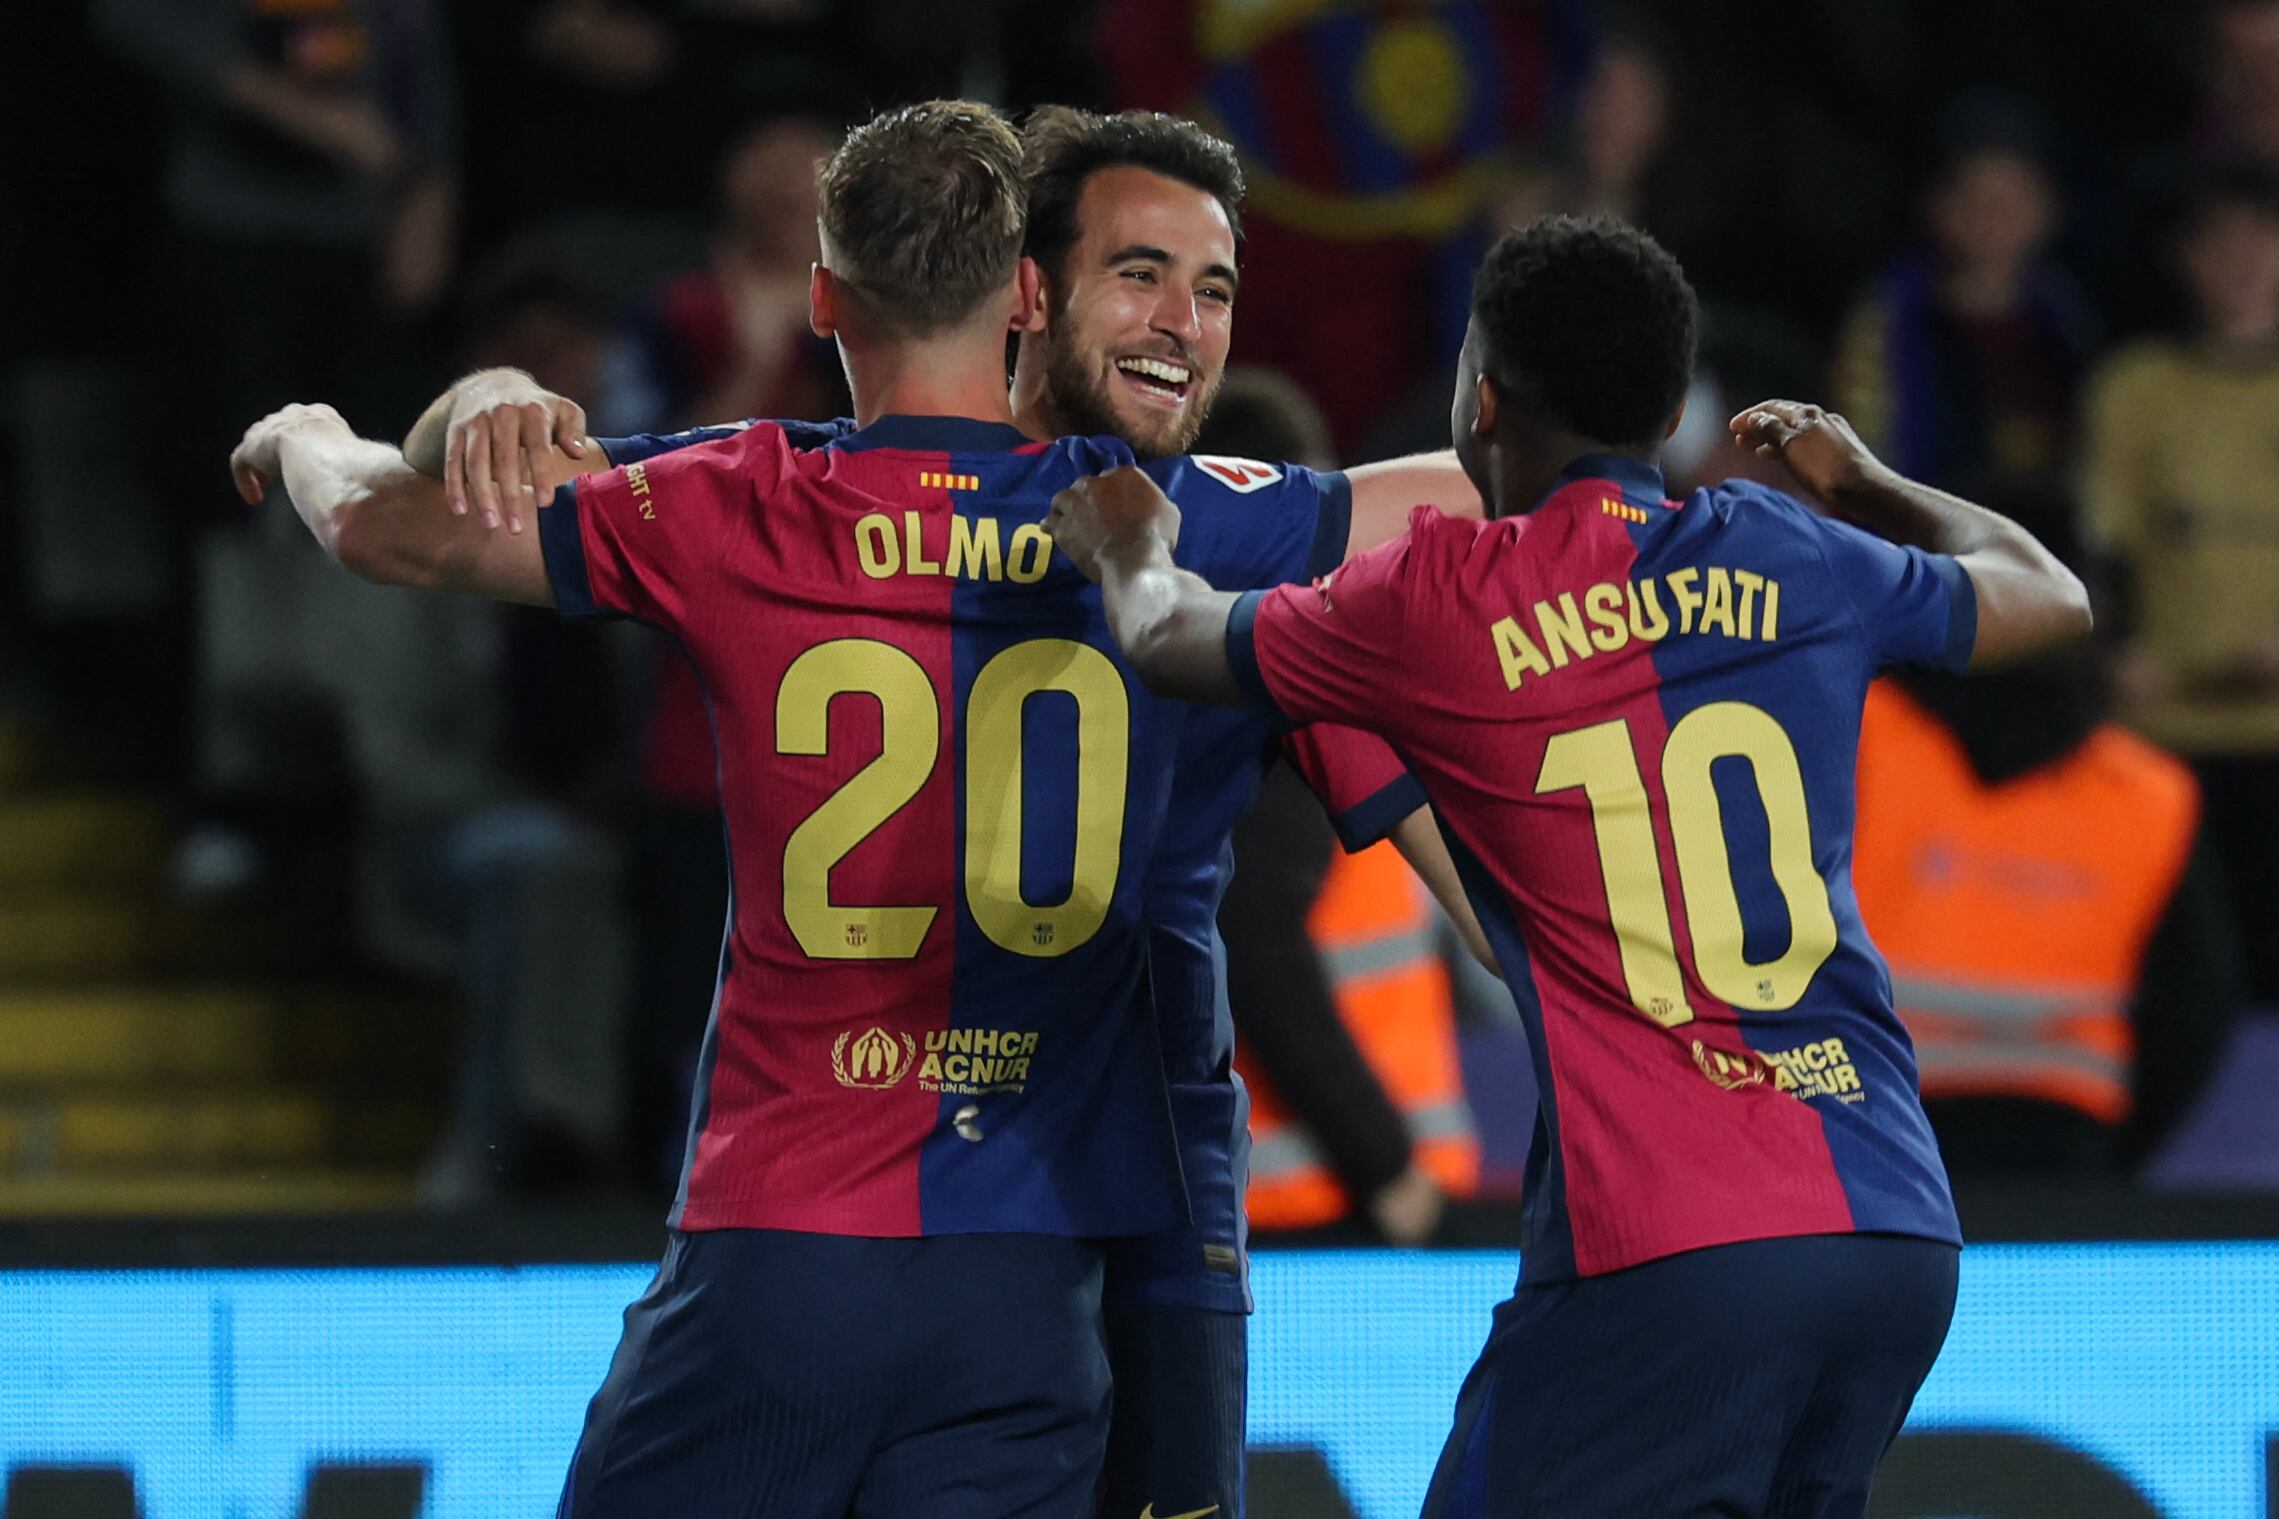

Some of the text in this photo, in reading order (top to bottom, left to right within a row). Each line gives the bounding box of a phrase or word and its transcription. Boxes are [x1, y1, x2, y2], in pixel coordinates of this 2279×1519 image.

[639, 499, 656, 519] tv
[855, 511, 1052, 583] OLMO
[1490, 566, 1779, 691] ANSU FATI
[775, 638, 1130, 959] 20
[1534, 701, 1838, 1027] 10
[918, 1053, 1030, 1083] ACNUR
[925, 1029, 1039, 1057] UNHCR
[940, 1082, 957, 1094] UN
